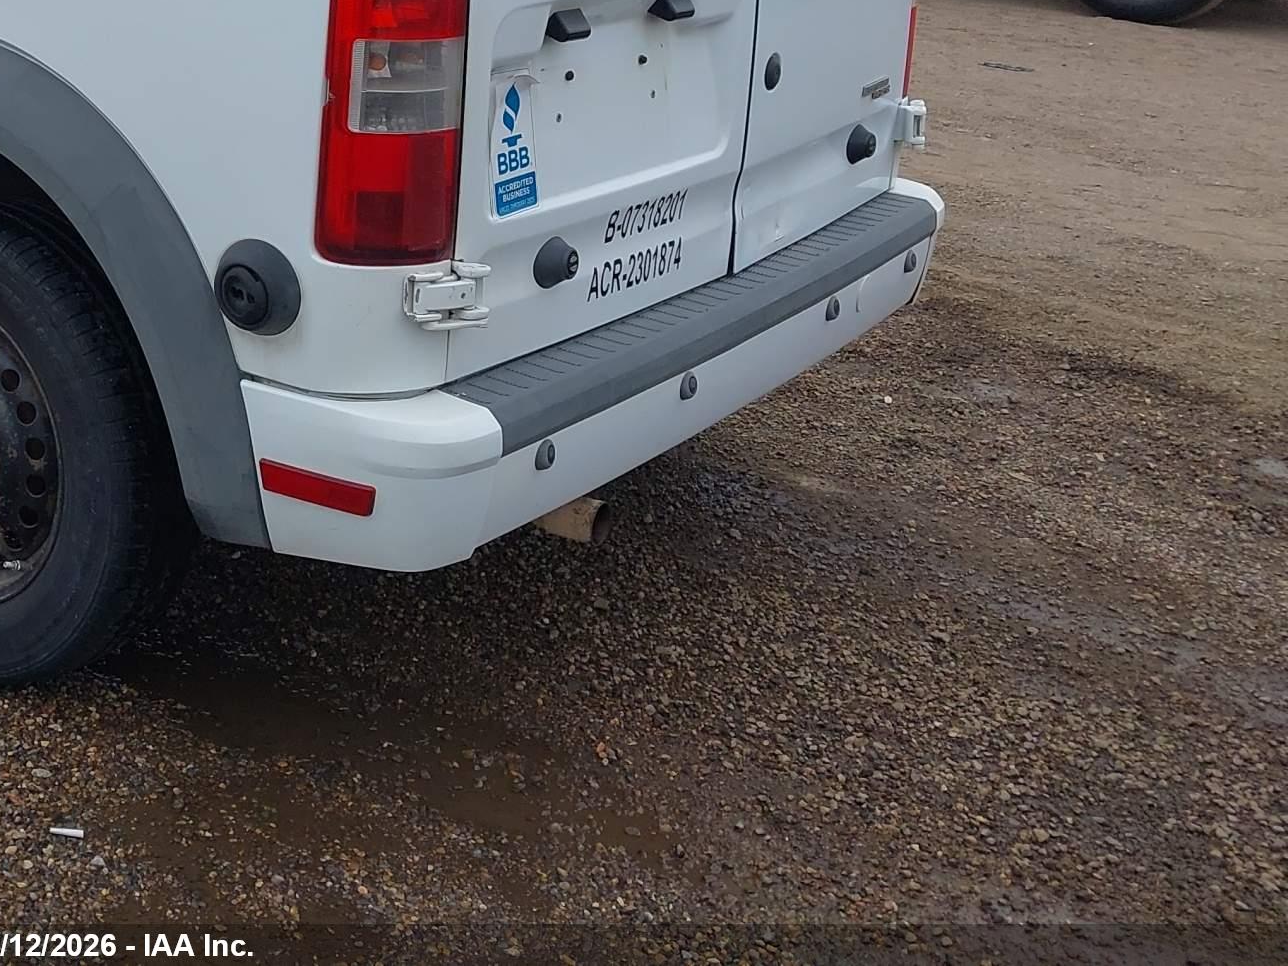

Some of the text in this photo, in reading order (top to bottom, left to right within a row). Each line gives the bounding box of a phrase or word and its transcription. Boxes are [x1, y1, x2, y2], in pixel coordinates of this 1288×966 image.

[497, 146, 530, 176] BBB
[498, 177, 534, 195] ACCREDITED
[502, 187, 531, 203] BUSINESS
[604, 187, 689, 244] B-07318201
[586, 237, 682, 302] ACR-2301874
